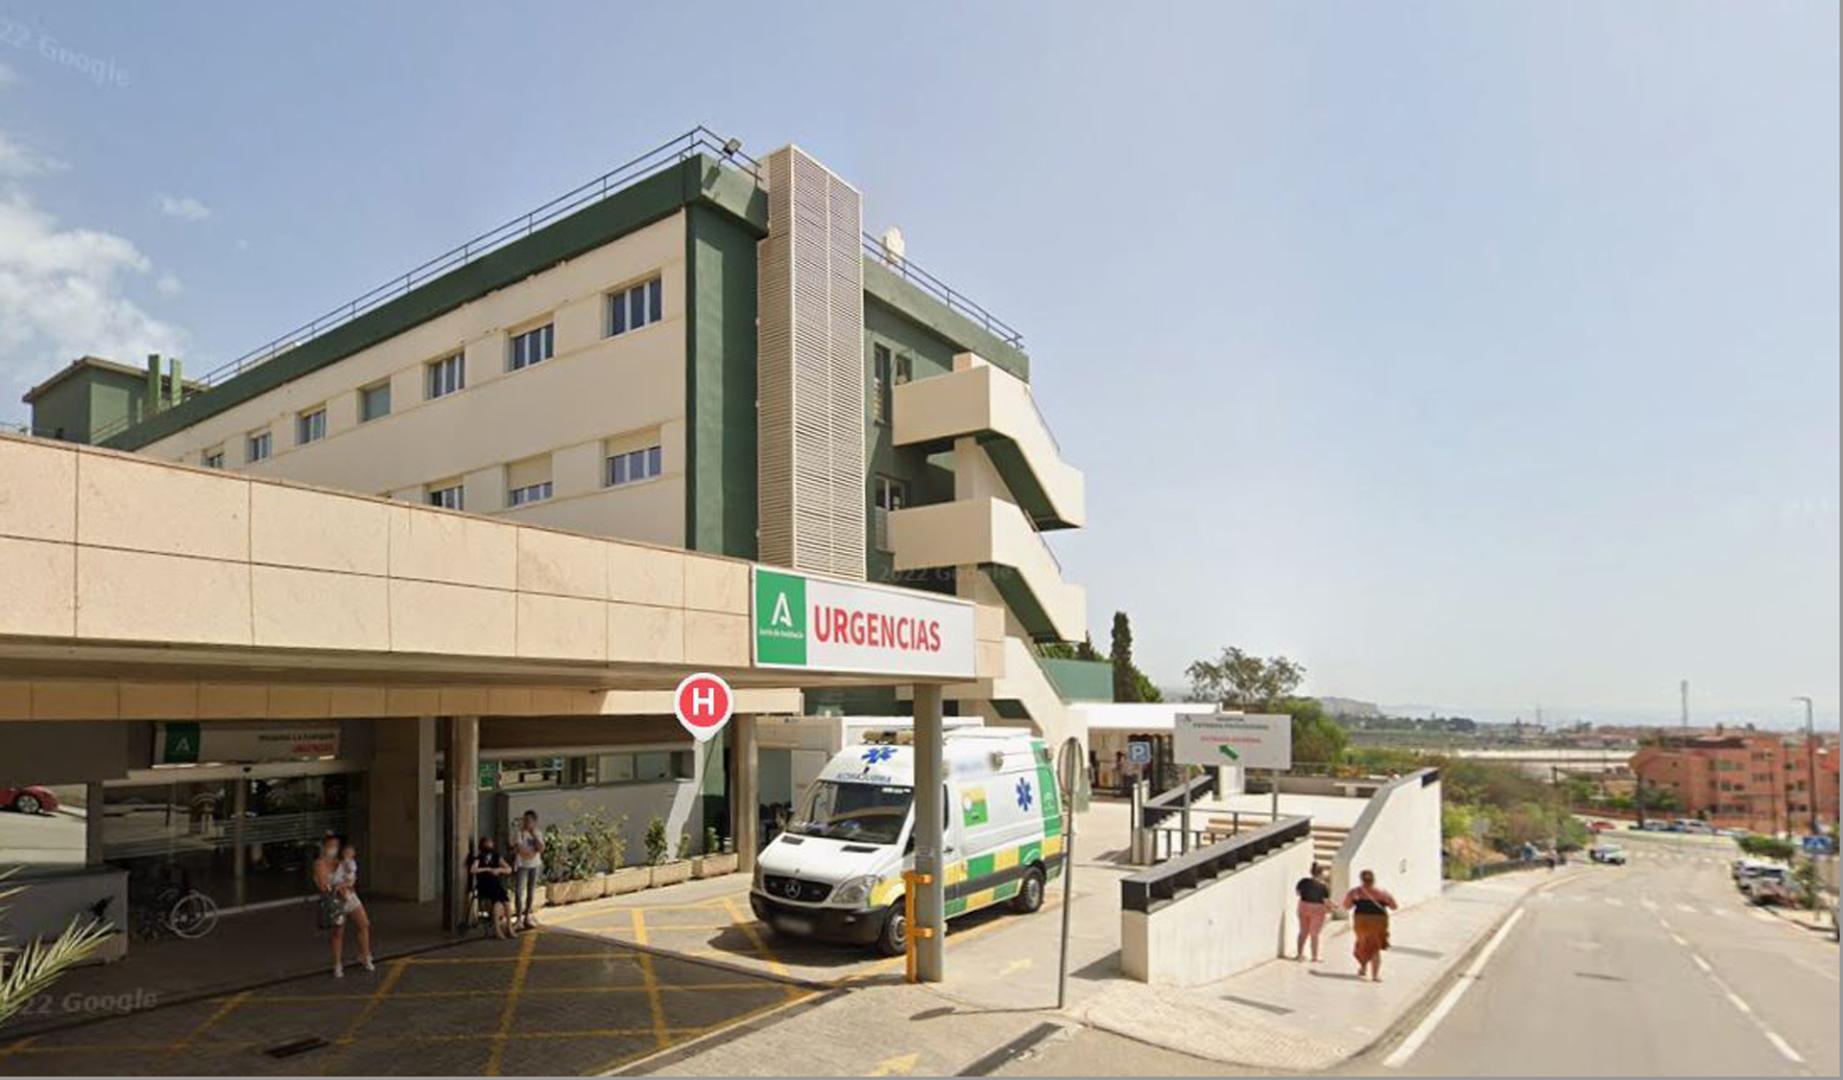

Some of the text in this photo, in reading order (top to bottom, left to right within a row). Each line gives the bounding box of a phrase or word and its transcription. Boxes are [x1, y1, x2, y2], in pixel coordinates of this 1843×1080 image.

[814, 604, 941, 652] URGENCIAS
[692, 687, 715, 717] H
[1132, 746, 1146, 762] P
